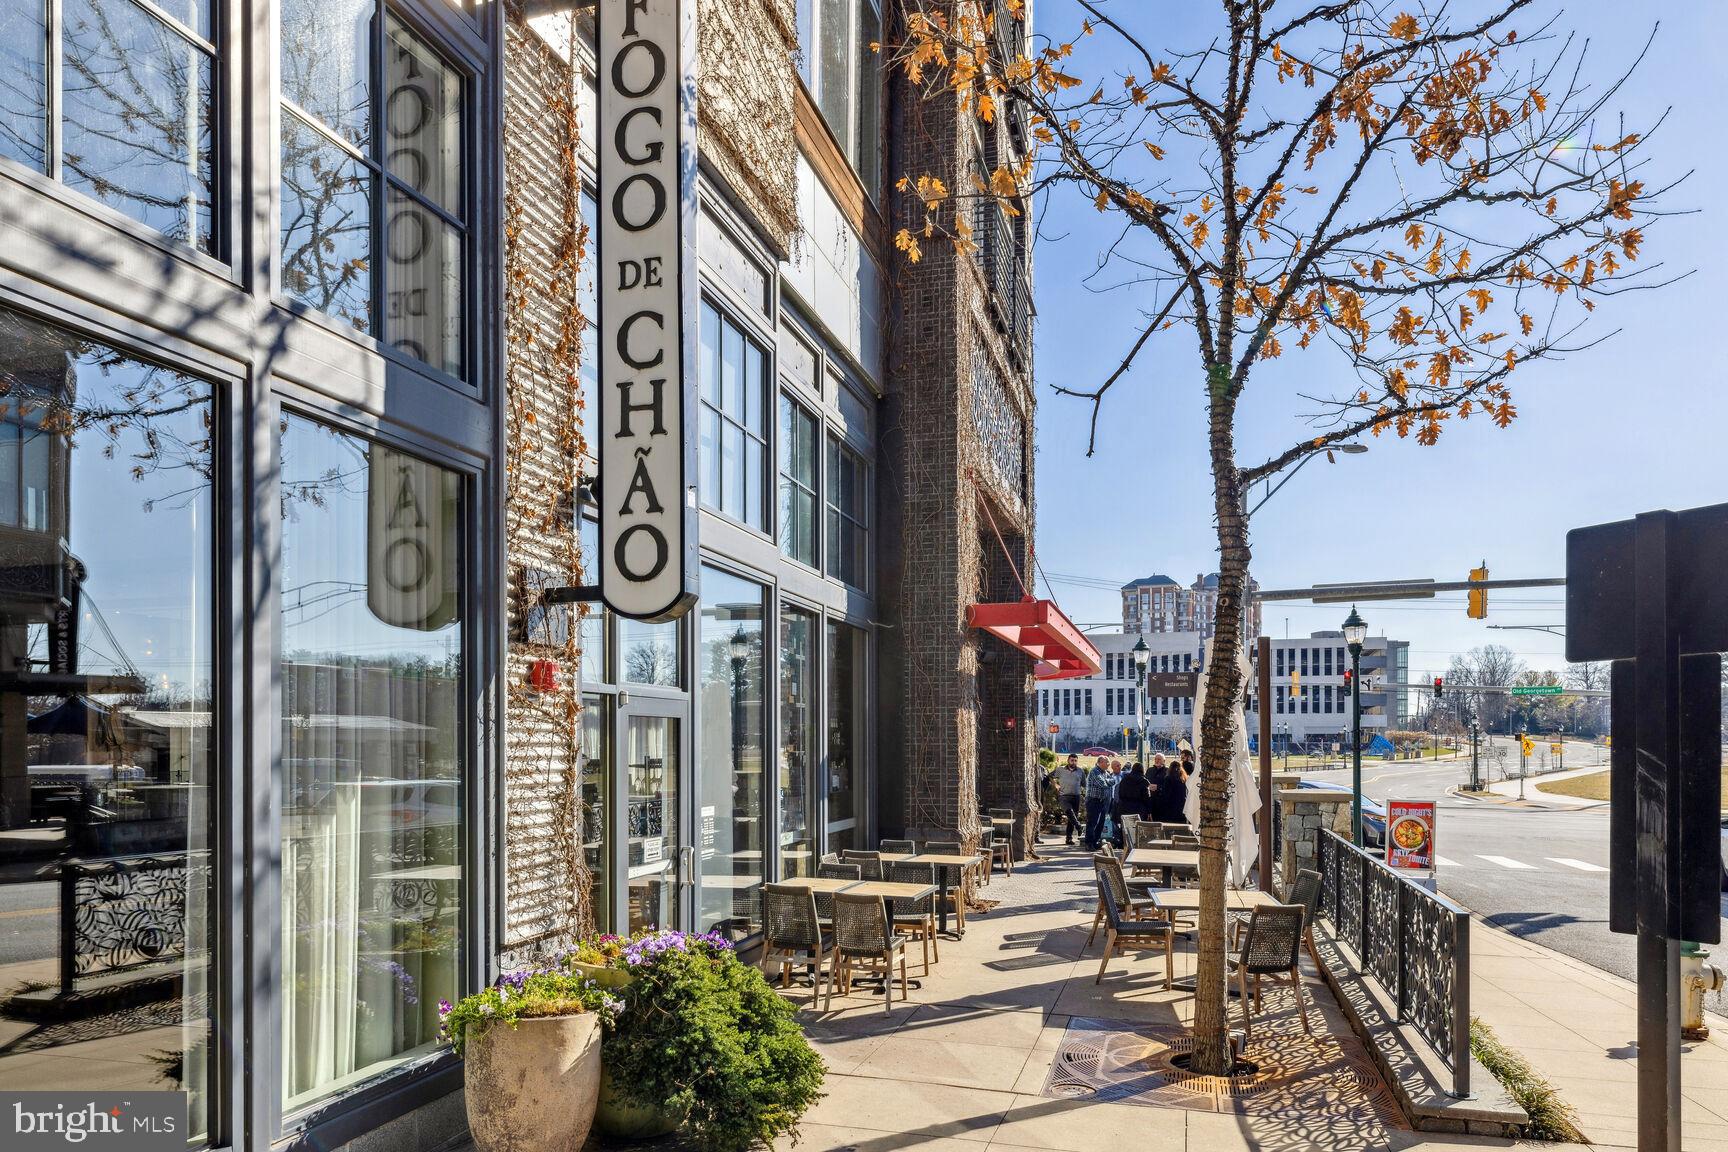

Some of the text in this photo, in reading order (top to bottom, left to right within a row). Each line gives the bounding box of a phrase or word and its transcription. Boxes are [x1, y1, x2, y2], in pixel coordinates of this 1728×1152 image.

[611, 0, 669, 583] FOGO DE CHÃO
